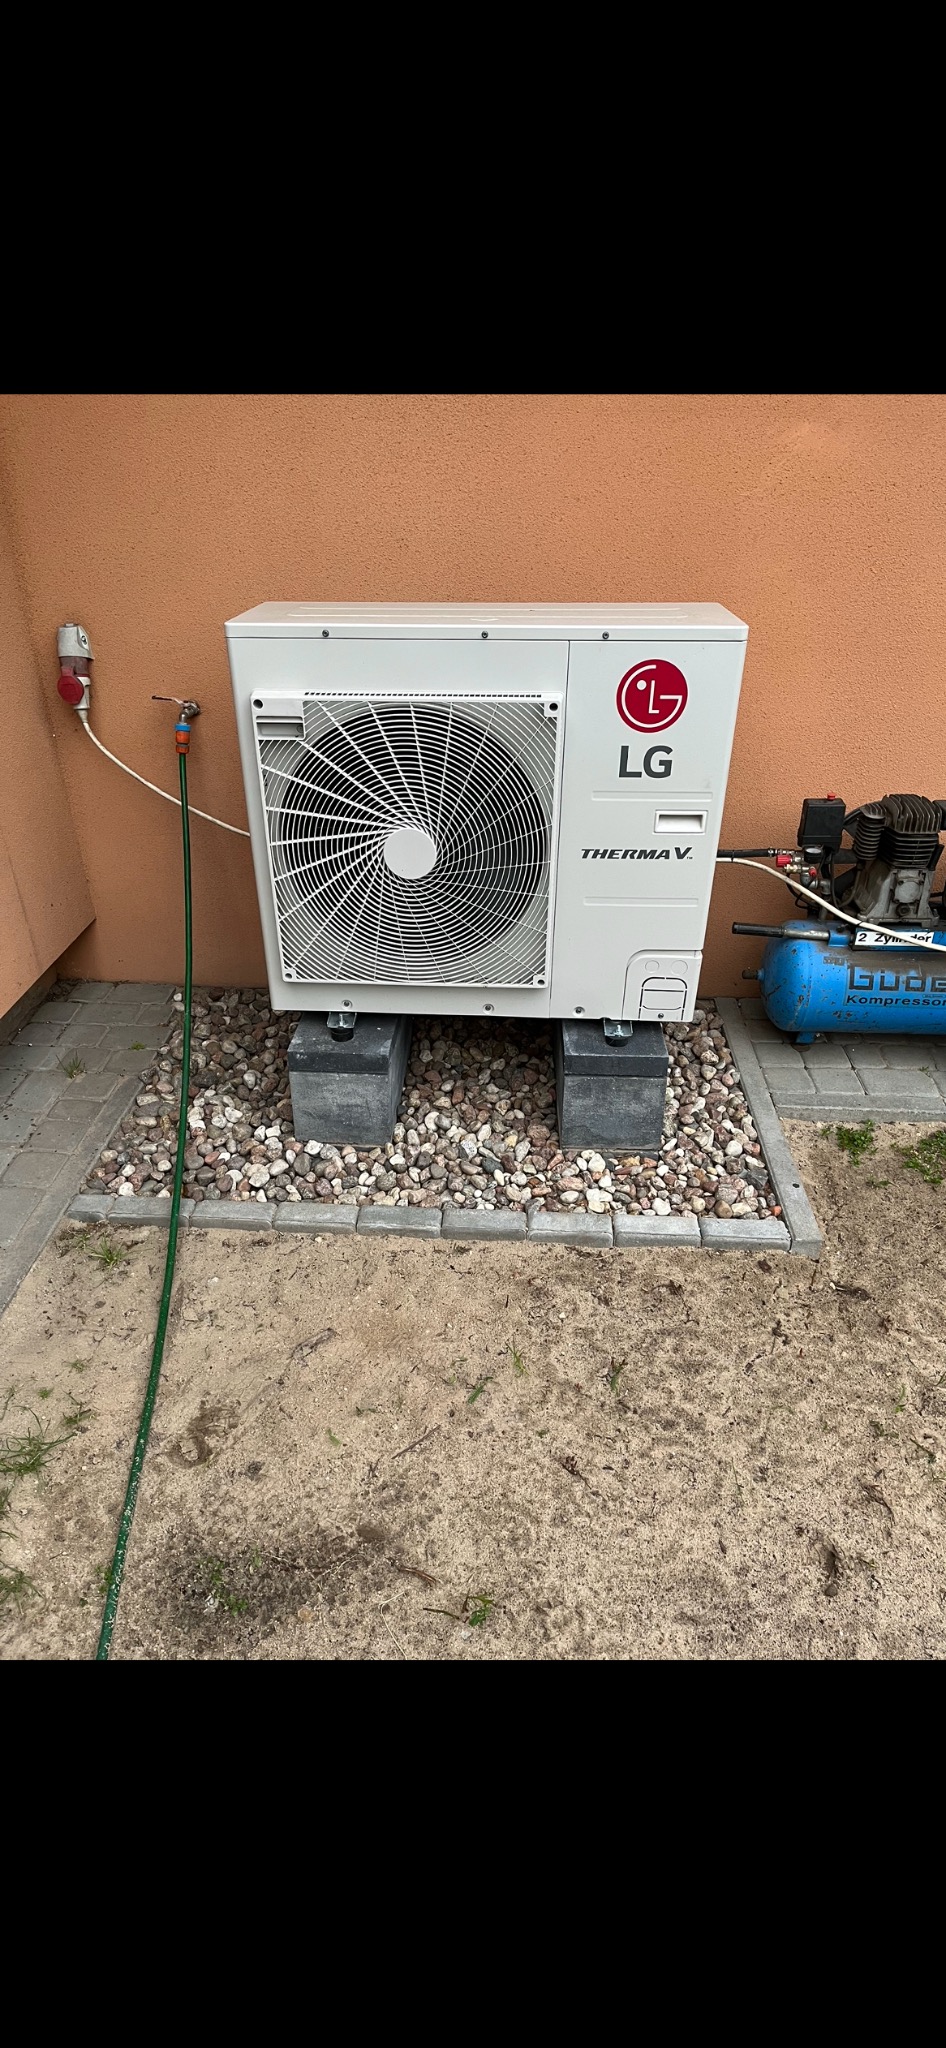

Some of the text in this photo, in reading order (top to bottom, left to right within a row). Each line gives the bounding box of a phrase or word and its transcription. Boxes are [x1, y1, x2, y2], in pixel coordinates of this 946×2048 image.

[618, 745, 674, 779] LG
[581, 848, 671, 860] THERMA
[857, 932, 868, 942] 2
